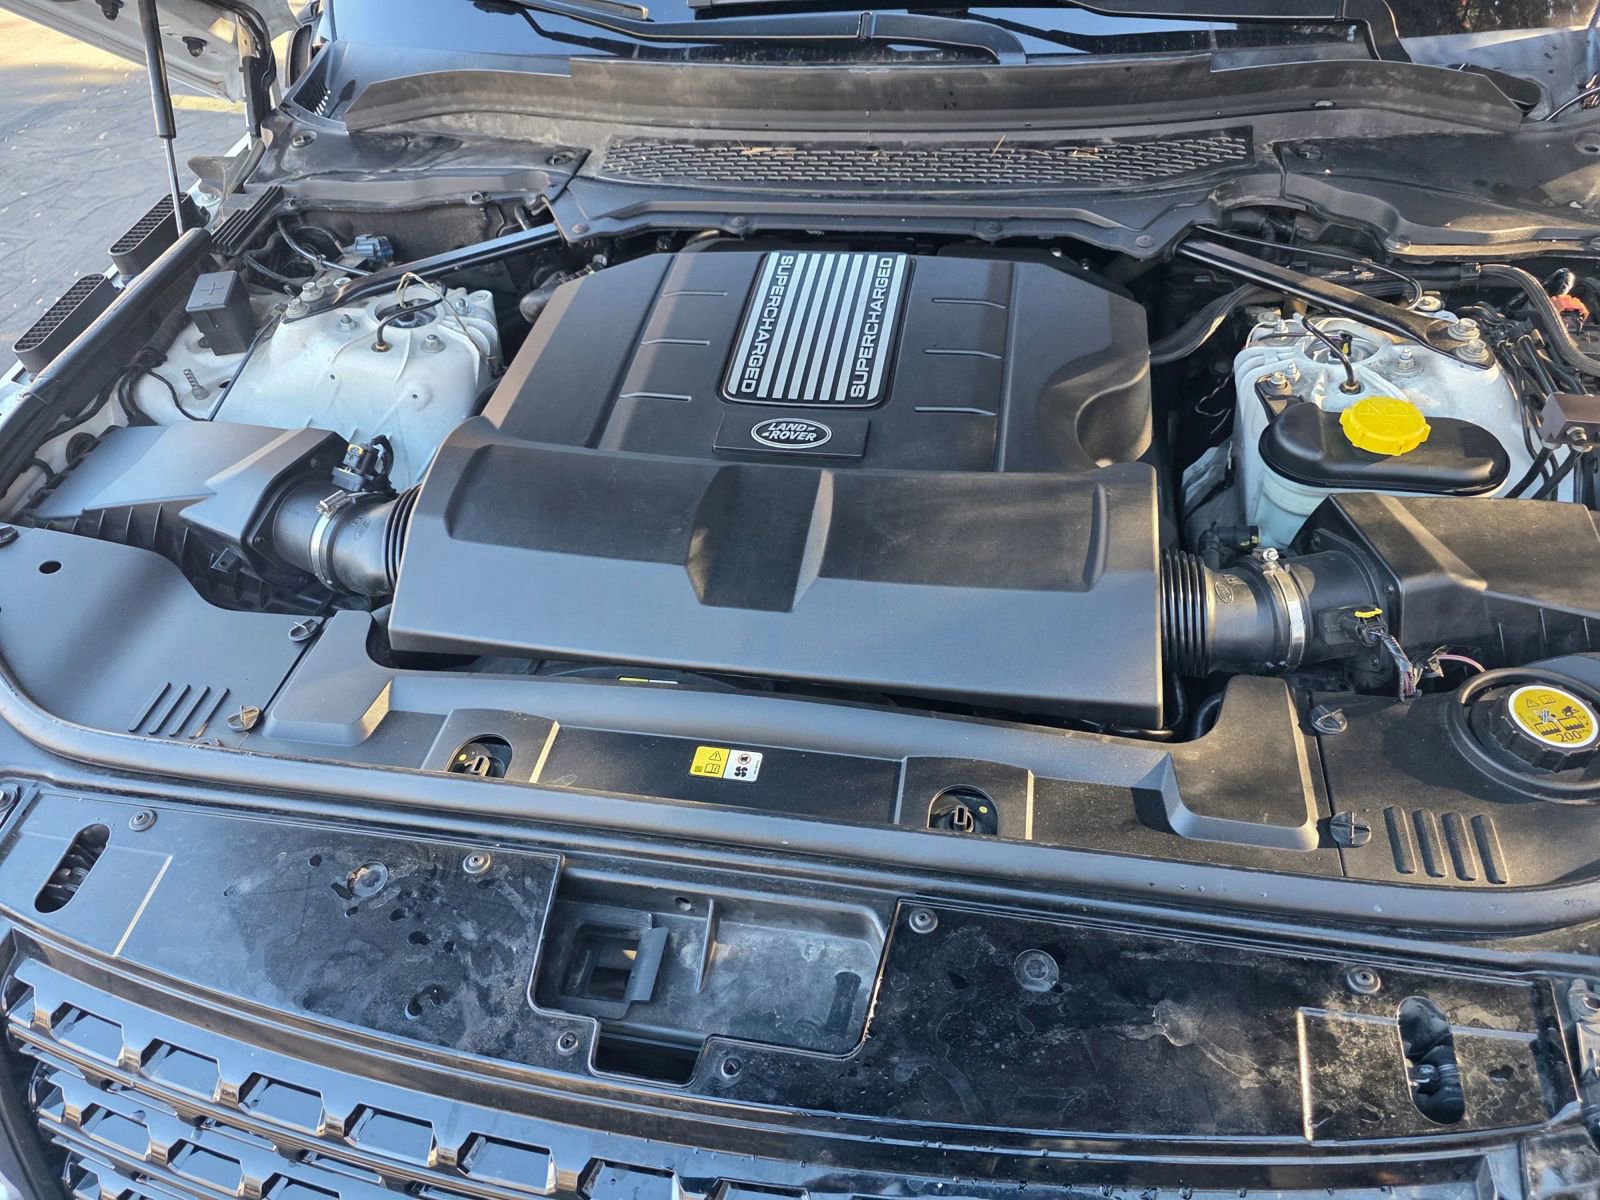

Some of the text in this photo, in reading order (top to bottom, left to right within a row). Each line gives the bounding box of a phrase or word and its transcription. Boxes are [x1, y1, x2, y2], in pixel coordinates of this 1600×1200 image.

[741, 255, 794, 393] SUPERCHARGED
[850, 257, 893, 398] SUPERCHARGED
[768, 422, 807, 432] LAND
[769, 431, 817, 441] ROVER
[1556, 730, 1583, 742] 200
